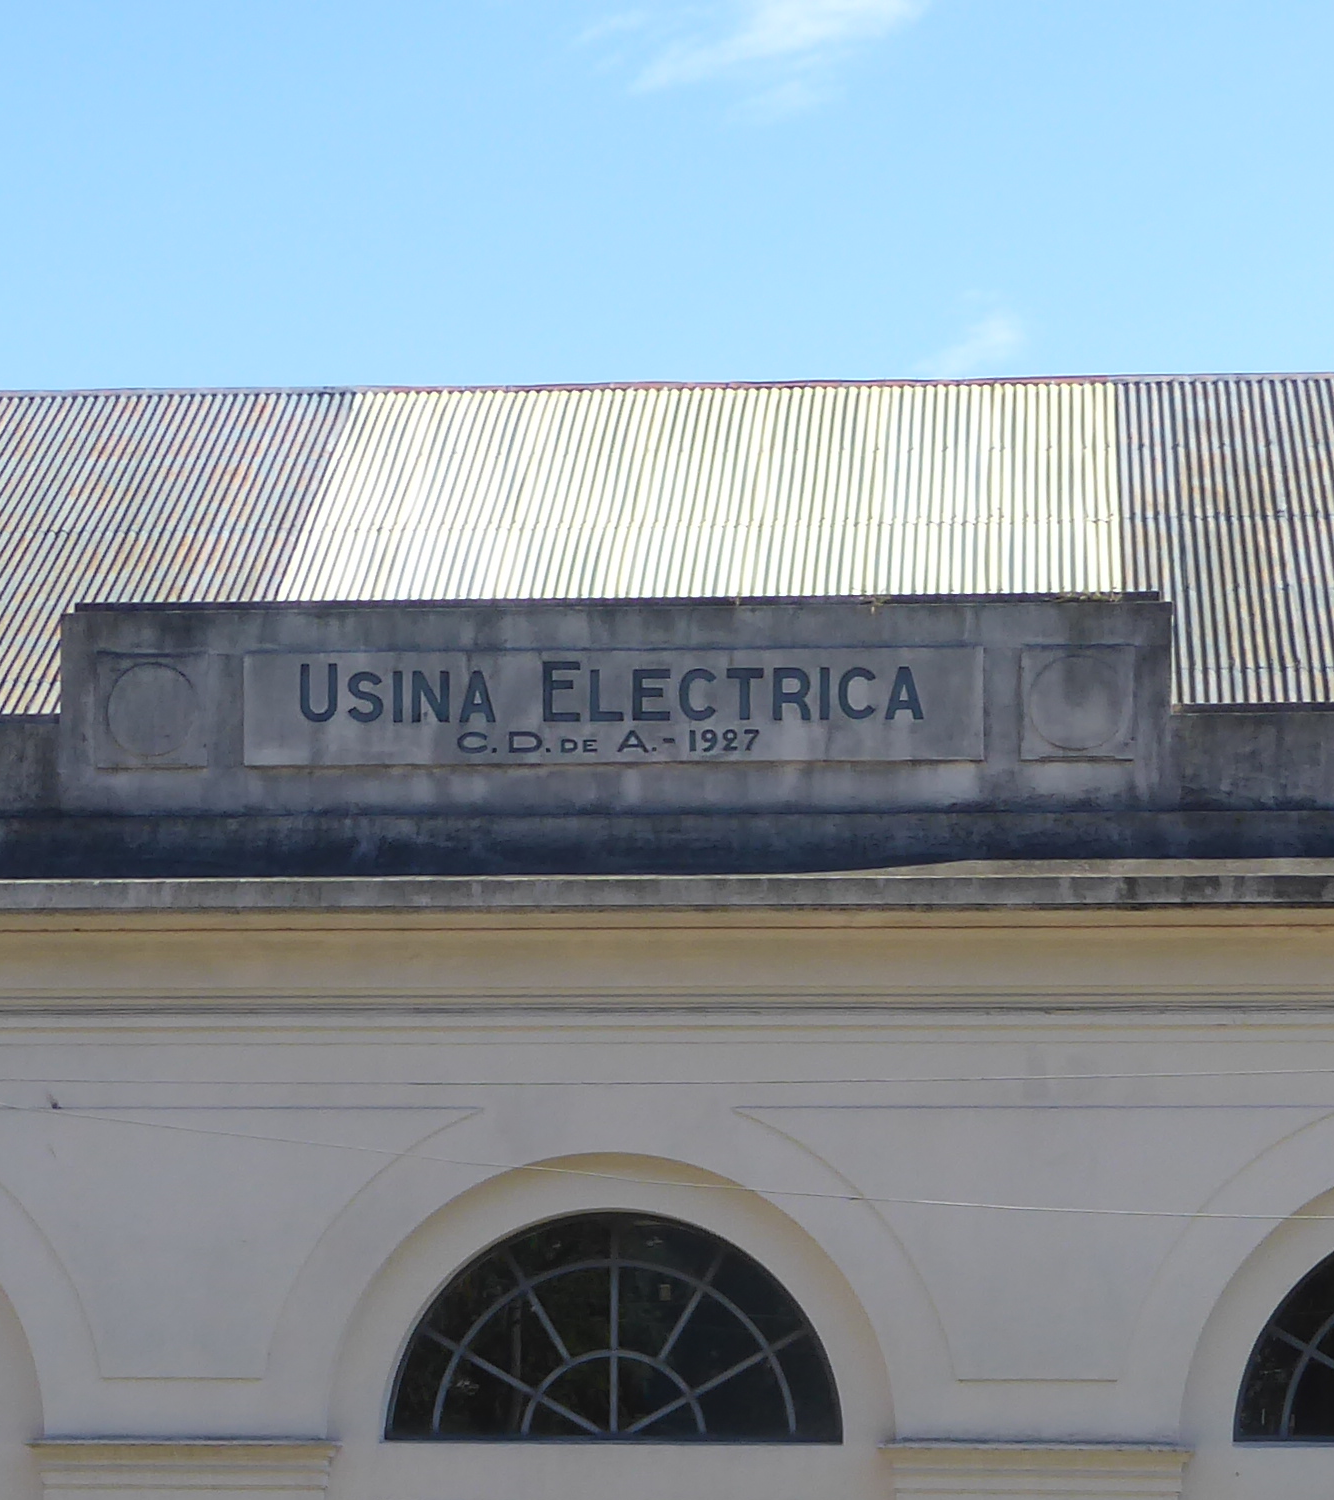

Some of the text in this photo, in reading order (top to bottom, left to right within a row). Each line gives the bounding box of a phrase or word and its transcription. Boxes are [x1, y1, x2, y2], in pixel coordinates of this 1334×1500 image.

[299, 660, 925, 724] USINA ELECTRICA
[688, 728, 761, 752] 1927
